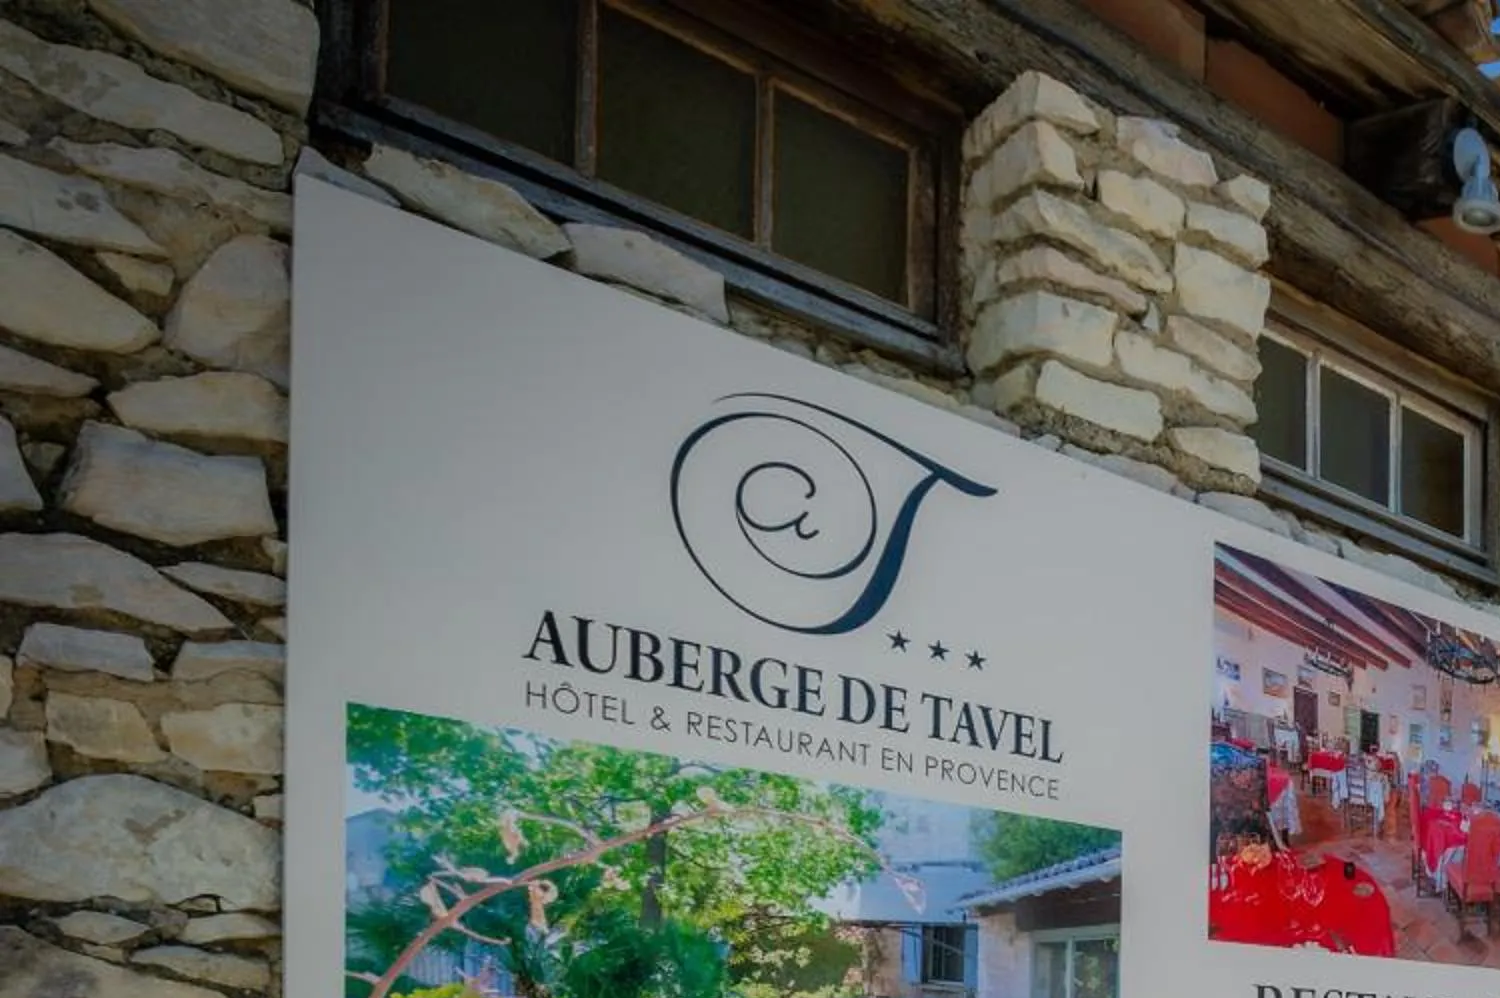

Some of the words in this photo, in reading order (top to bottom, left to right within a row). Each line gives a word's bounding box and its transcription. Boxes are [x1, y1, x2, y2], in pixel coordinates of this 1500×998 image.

[522, 609, 827, 718] AUBERGE
[836, 673, 911, 733] DE
[920, 692, 1064, 764] TAVEL
[525, 680, 636, 726] HÔTEL
[651, 705, 672, 733] &
[687, 710, 871, 768] RESTAURANT
[882, 749, 914, 774] EN
[925, 755, 1060, 801] PROVENCE
